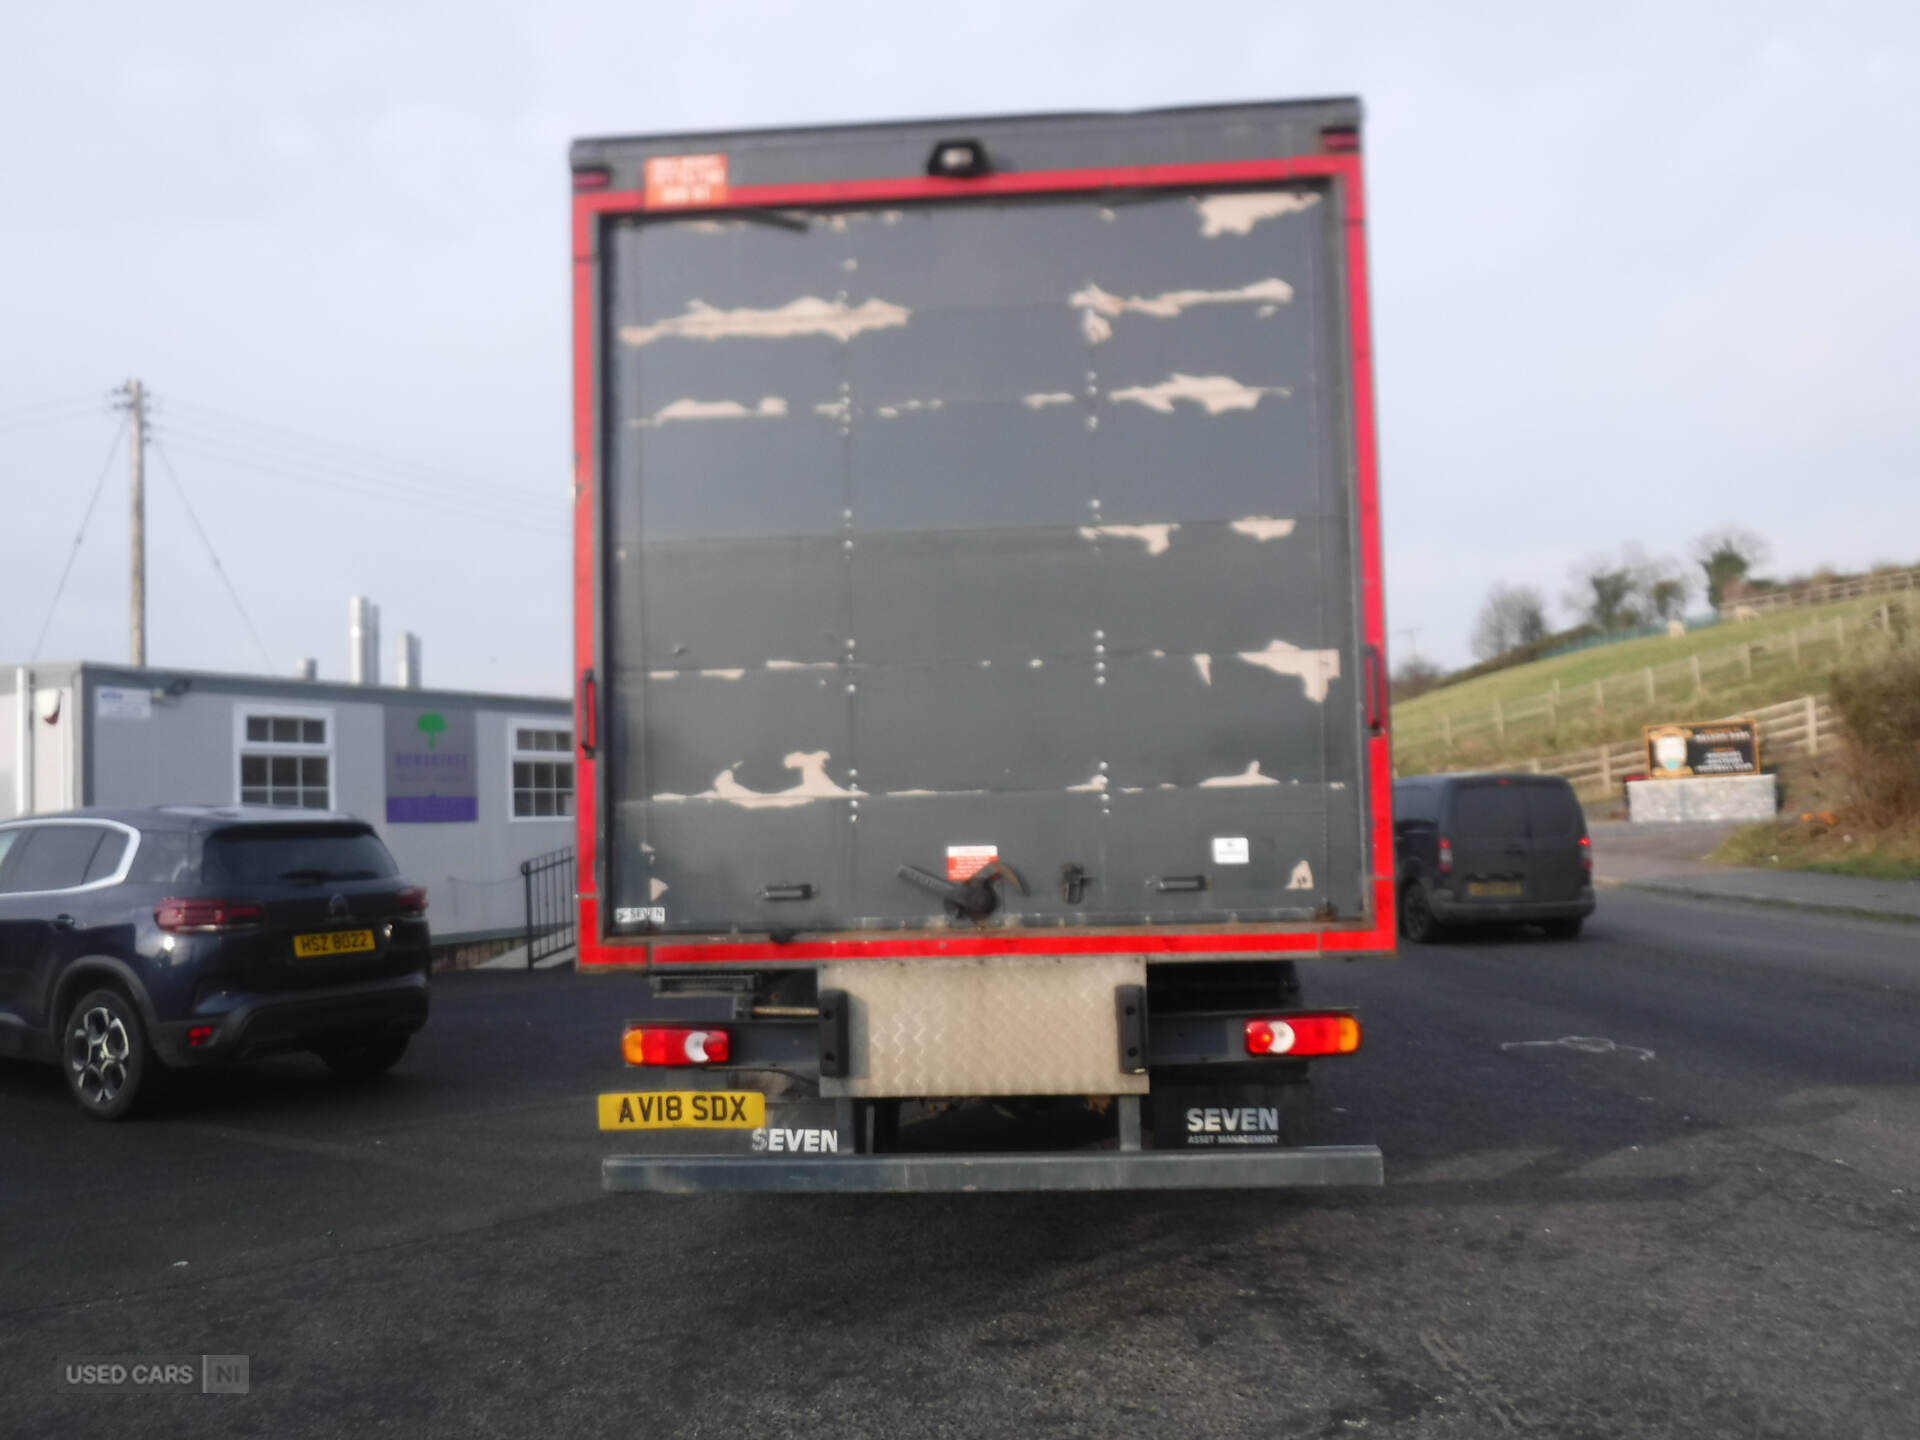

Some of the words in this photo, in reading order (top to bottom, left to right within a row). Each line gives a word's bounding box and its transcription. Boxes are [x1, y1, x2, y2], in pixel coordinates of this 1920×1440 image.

[619, 1096, 682, 1122] AV18
[693, 1096, 747, 1121] SDX
[1187, 1107, 1279, 1132] SEVEN
[752, 1128, 838, 1152] SEVEN
[1188, 1135, 1214, 1143] ASSET
[1218, 1134, 1279, 1143] MANAGEMENT
